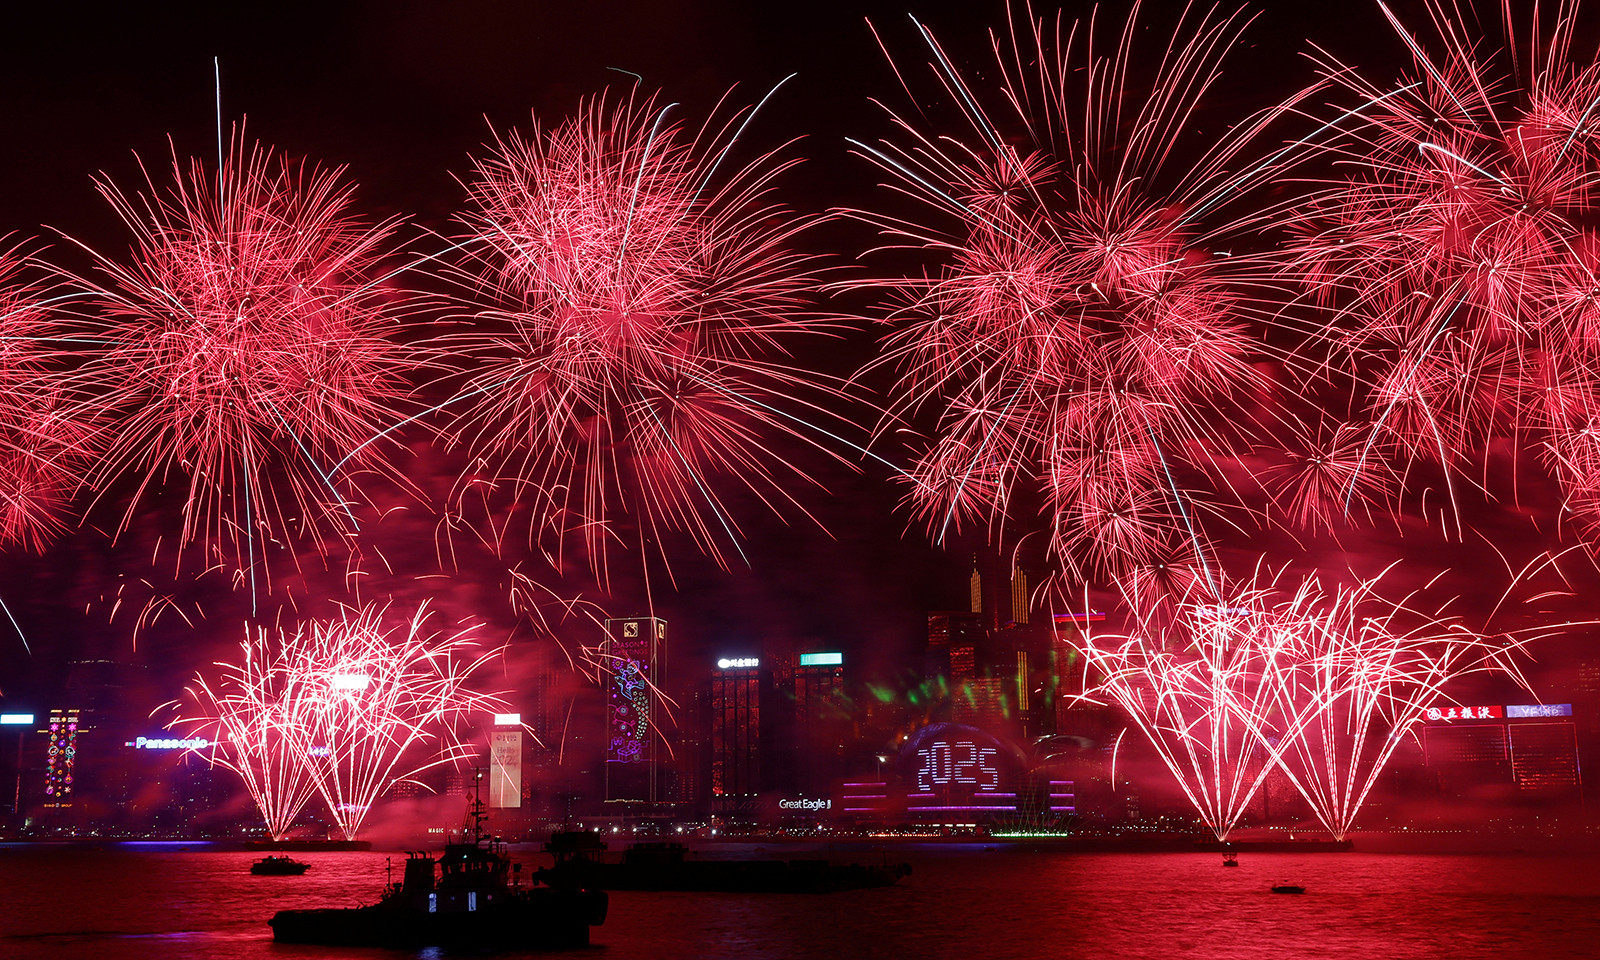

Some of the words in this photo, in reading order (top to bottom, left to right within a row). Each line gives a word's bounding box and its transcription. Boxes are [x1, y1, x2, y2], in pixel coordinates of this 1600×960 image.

[136, 737, 208, 749] Panasonic
[918, 741, 998, 790] 2025
[779, 799, 802, 809] Great
[803, 798, 826, 811] Eagle
